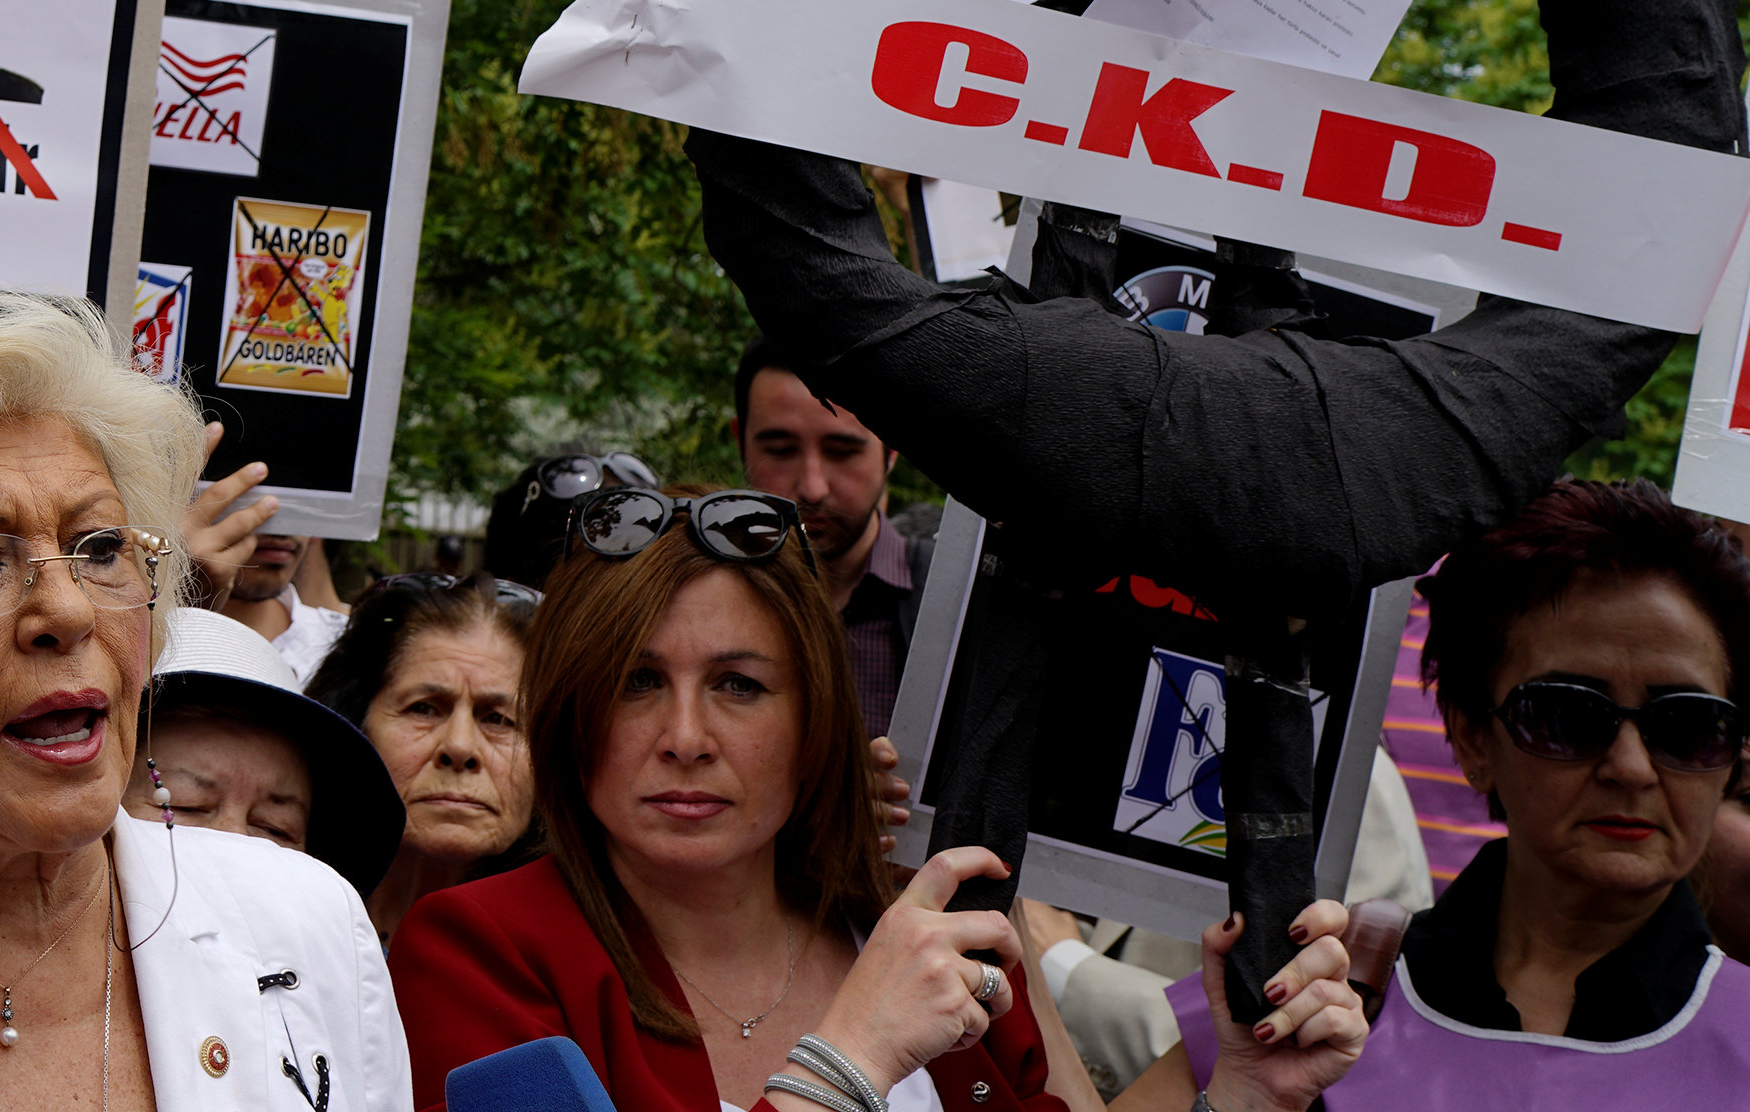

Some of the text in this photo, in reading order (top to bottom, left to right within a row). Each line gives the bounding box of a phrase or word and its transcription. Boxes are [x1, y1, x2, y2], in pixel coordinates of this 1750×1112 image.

[871, 21, 1562, 251] C.K.D.
[251, 224, 347, 259] HARIBO
[239, 339, 337, 367] GOLDBÄREN
